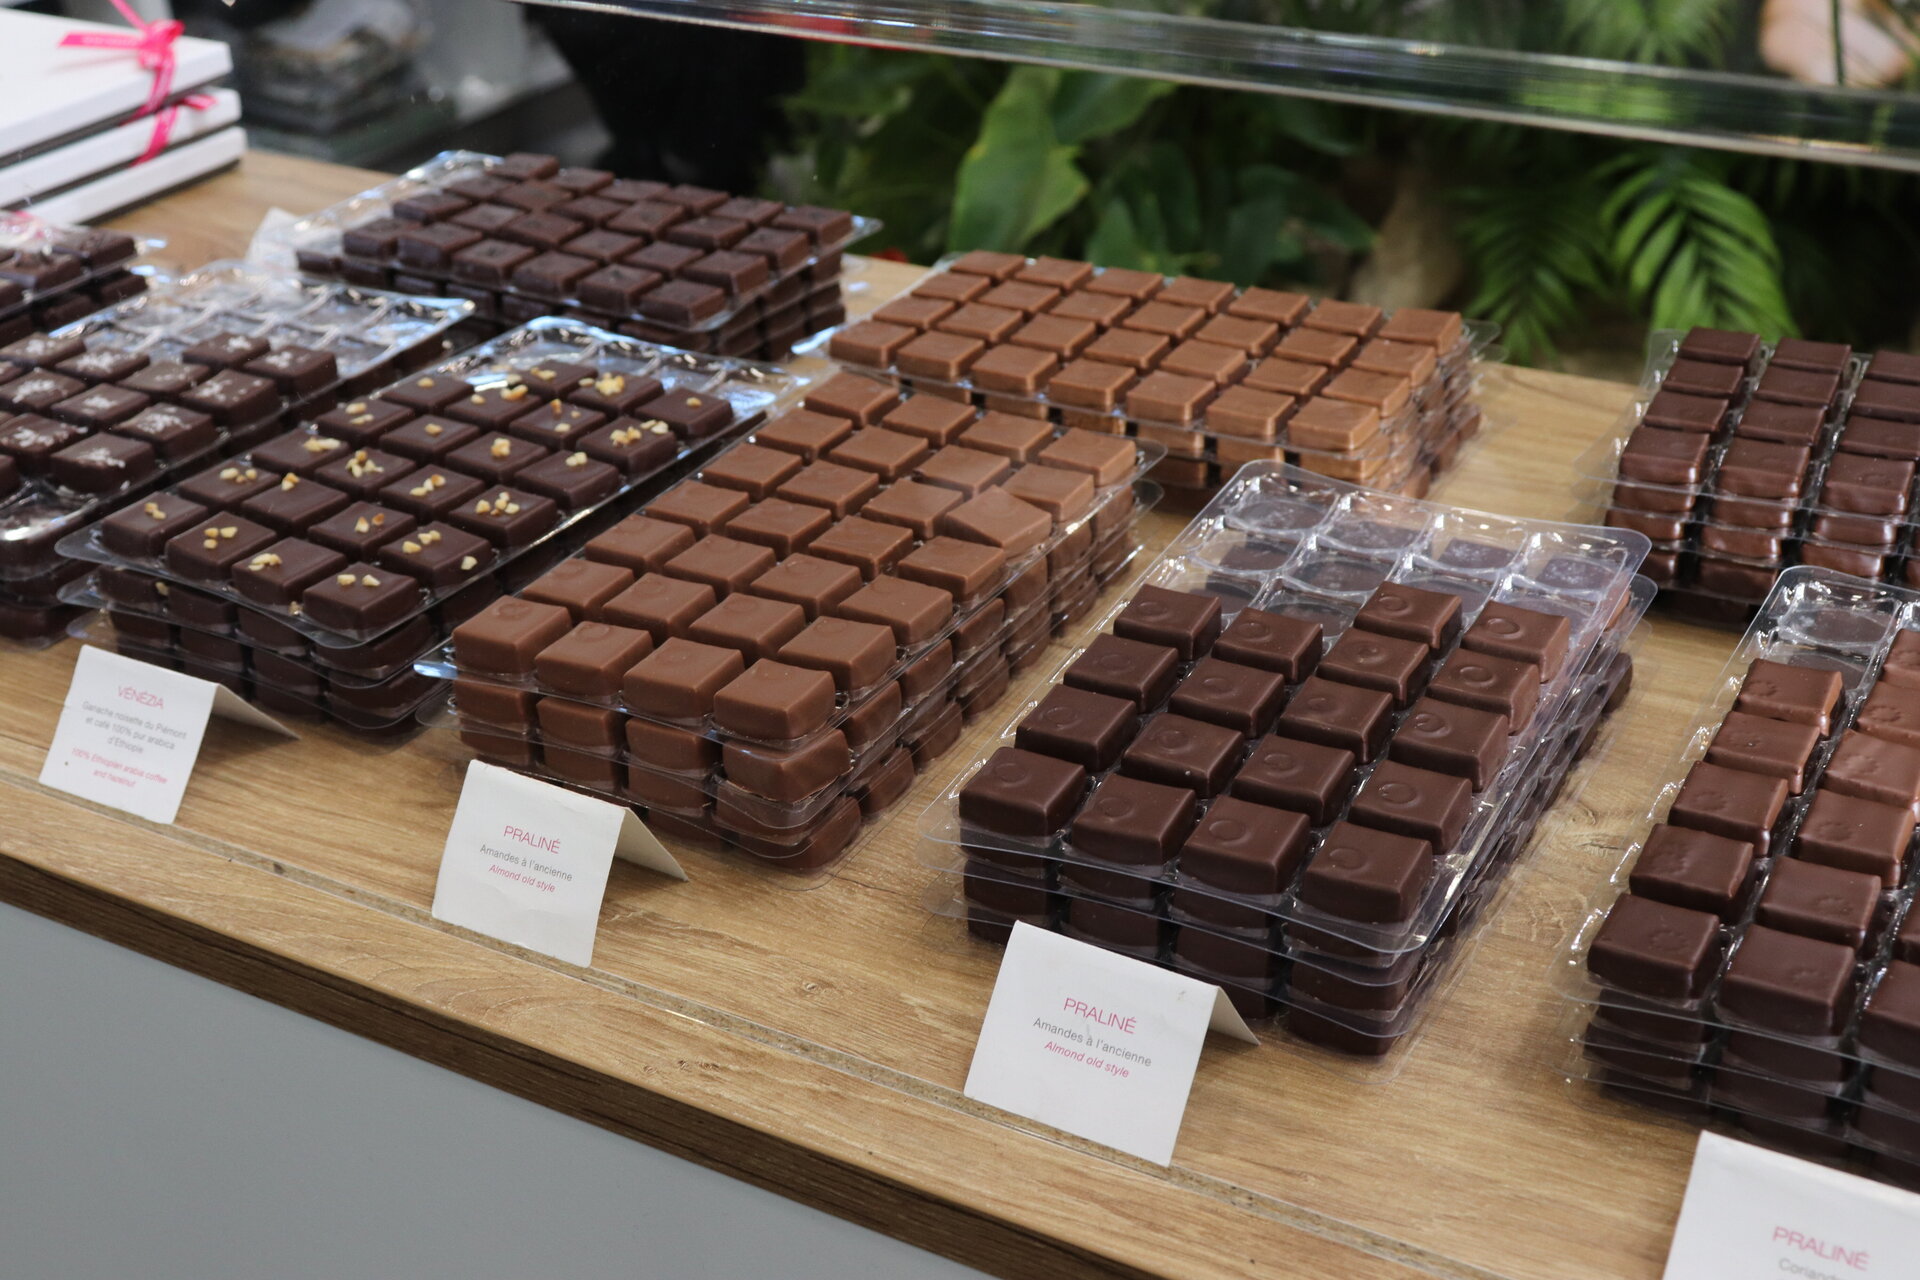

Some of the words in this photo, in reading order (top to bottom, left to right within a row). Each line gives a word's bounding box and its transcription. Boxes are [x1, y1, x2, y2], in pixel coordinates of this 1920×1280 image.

[82, 701, 113, 717] Ganache
[115, 712, 143, 726] noisette
[144, 721, 154, 731] du
[85, 716, 92, 725] et
[112, 724, 132, 737] 100%
[133, 731, 145, 742] pur
[147, 735, 176, 750] arabica
[72, 747, 90, 761] 100%
[145, 771, 168, 784] coffee
[93, 769, 107, 779] and
[107, 772, 137, 788] hazelnut
[503, 825, 561, 854] PRALINÉ
[479, 844, 520, 865] Amandes
[521, 857, 527, 867] à
[488, 864, 522, 881] Almond
[522, 875, 536, 886] old
[536, 880, 556, 893] style
[1063, 997, 1137, 1034] PRALINÉ
[1033, 1017, 1083, 1043] Amandes
[1085, 1034, 1093, 1047] à
[1044, 1041, 1085, 1063] Almond
[1086, 1054, 1104, 1069] old
[1105, 1061, 1130, 1078] style
[1772, 1226, 1870, 1271] PRALINÉ
